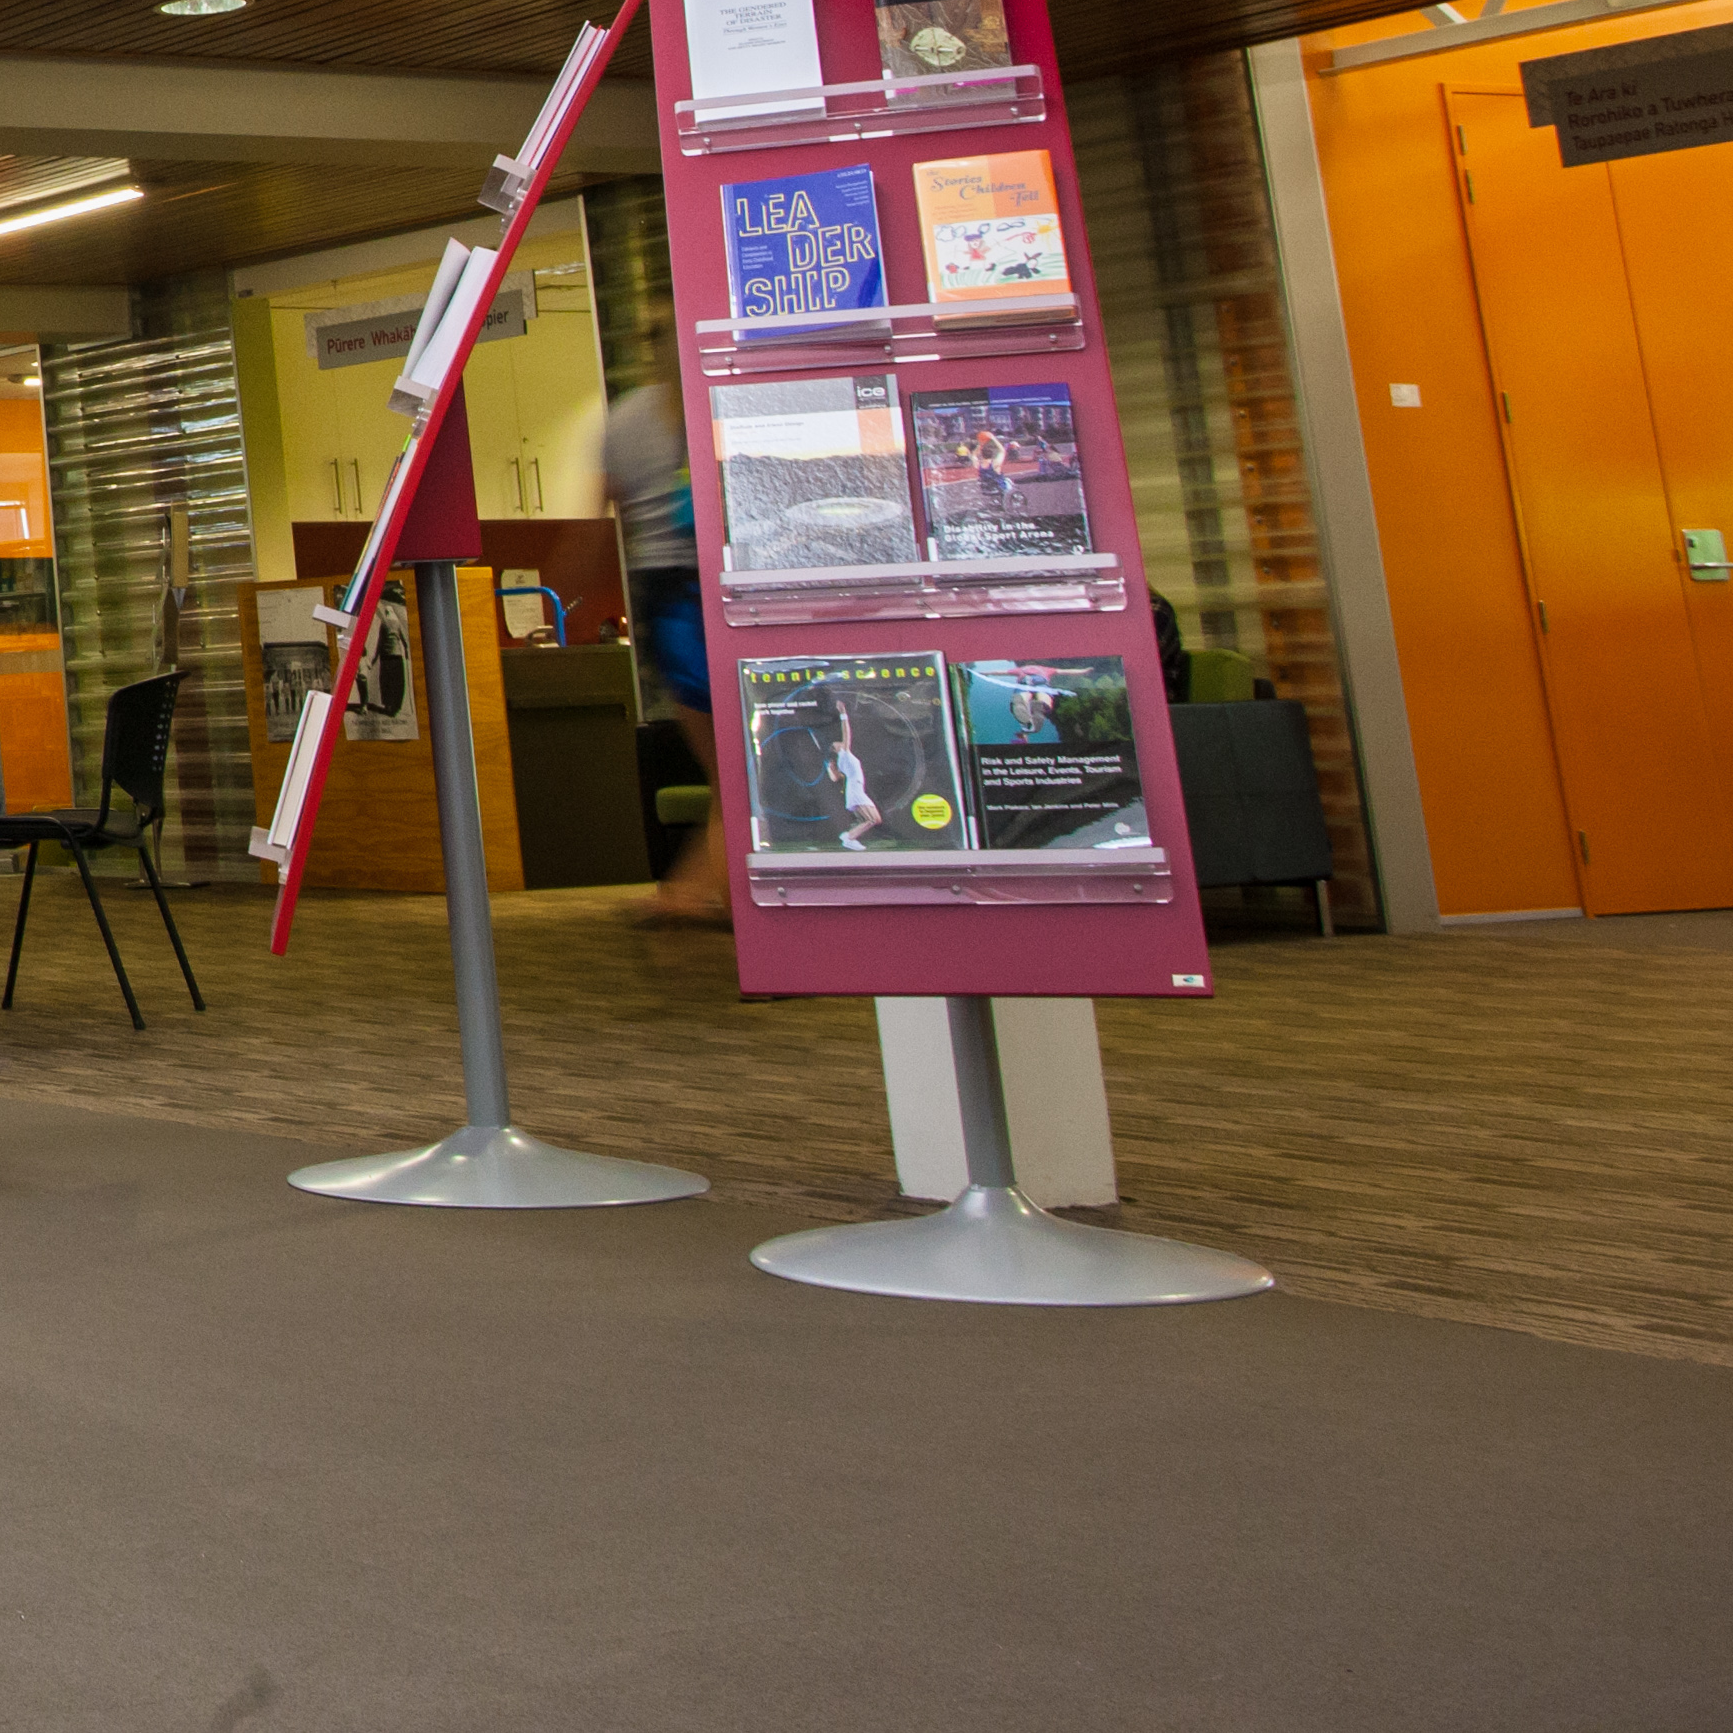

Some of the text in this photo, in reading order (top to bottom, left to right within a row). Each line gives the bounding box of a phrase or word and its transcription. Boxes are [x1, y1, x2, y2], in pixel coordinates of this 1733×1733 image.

[1566, 90, 1583, 107] Te
[1588, 87, 1616, 103] Ara
[1568, 104, 1644, 129] Rorohiko
[1647, 103, 1659, 116] a
[1572, 126, 1651, 151] Taupaepae
[1654, 116, 1717, 138] Ratonga
[931, 174, 982, 192] Stories
[959, 182, 1026, 200] Children
[744, 266, 851, 317] SHIP
[327, 333, 365, 354] Pūrere
[371, 326, 417, 346] Whakāh
[856, 385, 886, 398] ice
[985, 531, 1016, 541] Sport
[1020, 529, 1054, 539] Arena
[750, 666, 936, 683] tennis science
[981, 754, 1121, 766] Risk and Safety Management
[982, 767, 992, 775] in
[992, 767, 1008, 775] the
[1083, 765, 1123, 774] Tourism
[983, 776, 1083, 787] and Sports Industries
